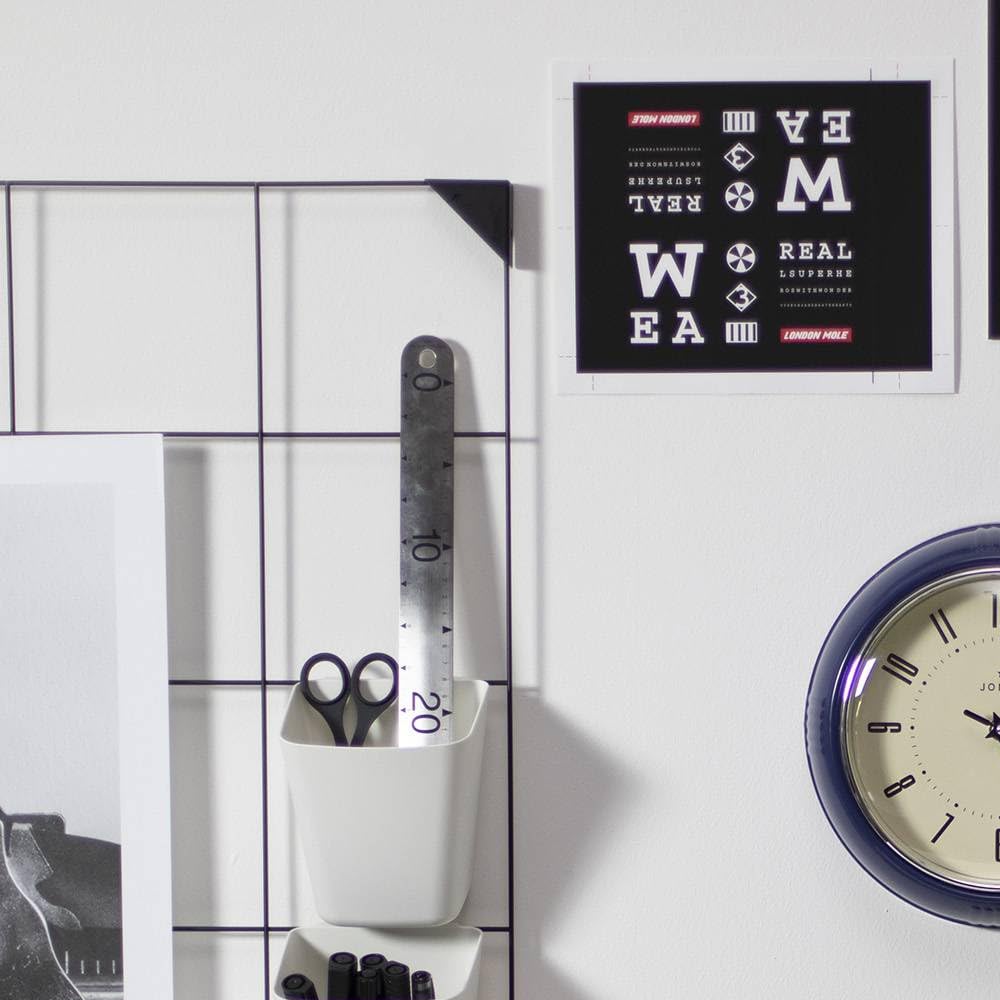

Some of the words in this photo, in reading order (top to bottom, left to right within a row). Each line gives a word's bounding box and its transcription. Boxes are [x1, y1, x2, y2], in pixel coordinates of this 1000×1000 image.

[631, 113, 658, 125] MOLE
[659, 112, 698, 125] LONDON
[628, 194, 702, 213] REAL
[779, 242, 852, 260] REAL
[629, 242, 704, 298] W
[783, 331, 821, 340] LONDON
[822, 331, 849, 340] MOLE
[411, 371, 442, 392] 0
[411, 529, 441, 563] 10
[881, 653, 920, 686] 10
[411, 690, 443, 735] 20
[867, 721, 902, 734] 9
[883, 774, 916, 799] 8
[930, 812, 955, 844] 7
